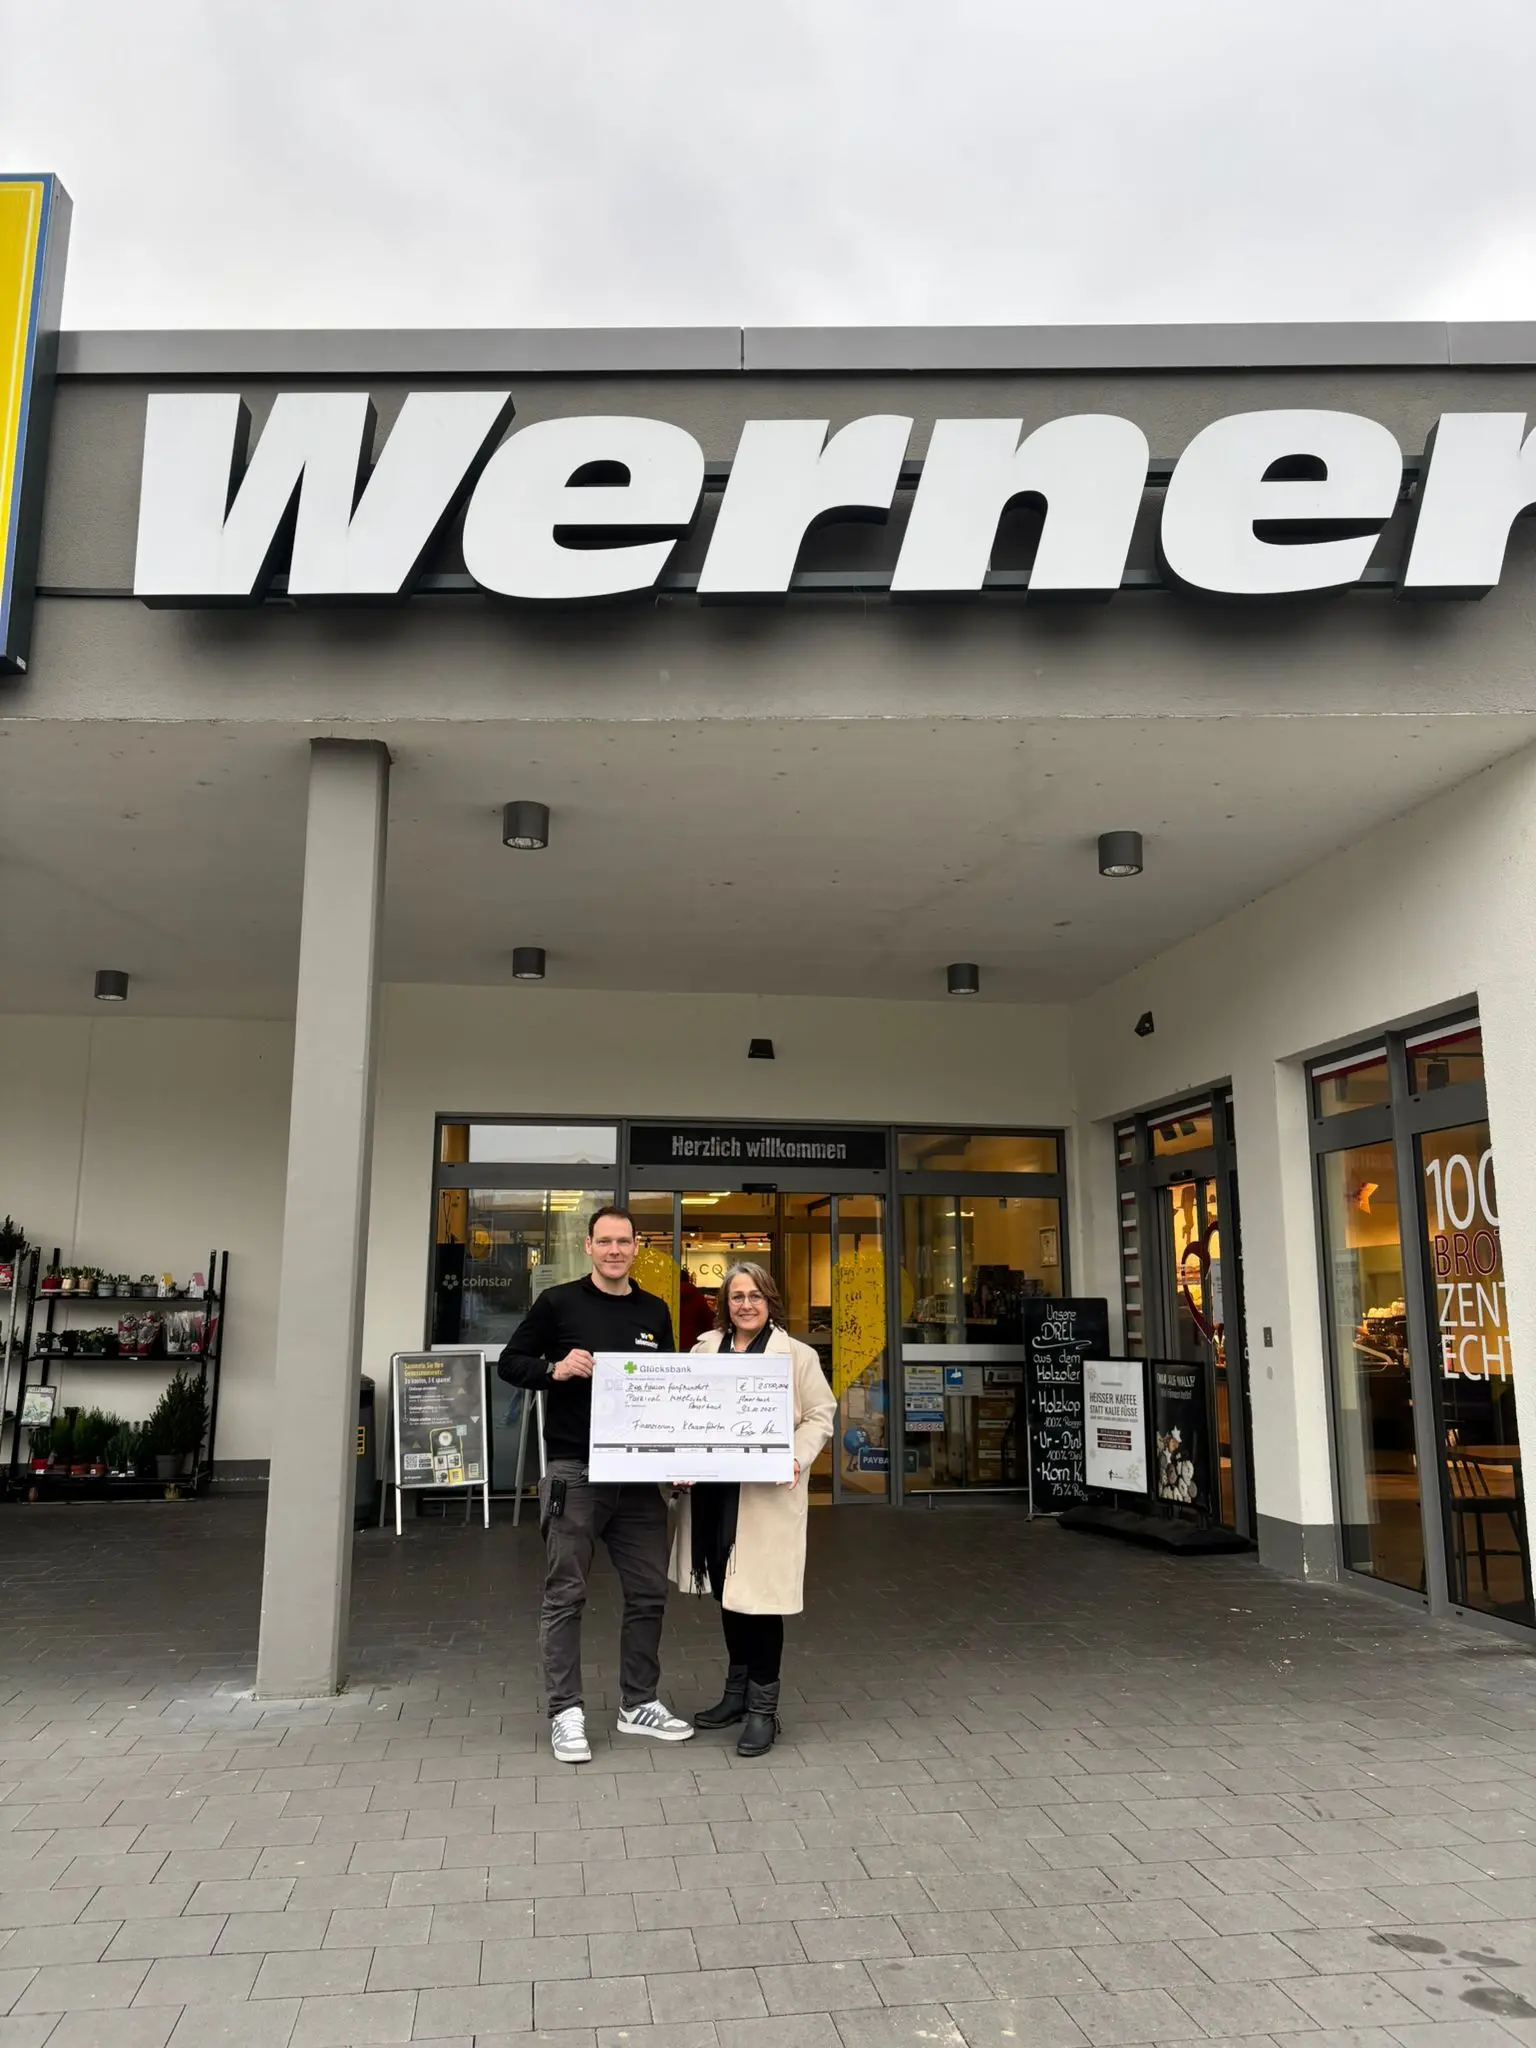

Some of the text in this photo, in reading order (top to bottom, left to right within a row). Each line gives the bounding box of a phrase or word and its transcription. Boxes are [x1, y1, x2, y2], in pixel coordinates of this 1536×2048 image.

[132, 389, 1536, 601] Werner
[671, 1135, 847, 1160] Herzlich willkommen
[462, 1275, 513, 1287] coinstar
[1046, 1304, 1077, 1321] Unsere
[1033, 1348, 1080, 1364] aus dem
[639, 1364, 692, 1374] Glücksbank
[1089, 1391, 1138, 1406] HEISSER KAFFEE
[1089, 1404, 1138, 1417] STATT KALTE FÜSSE
[1041, 1462, 1070, 1481] Korn
